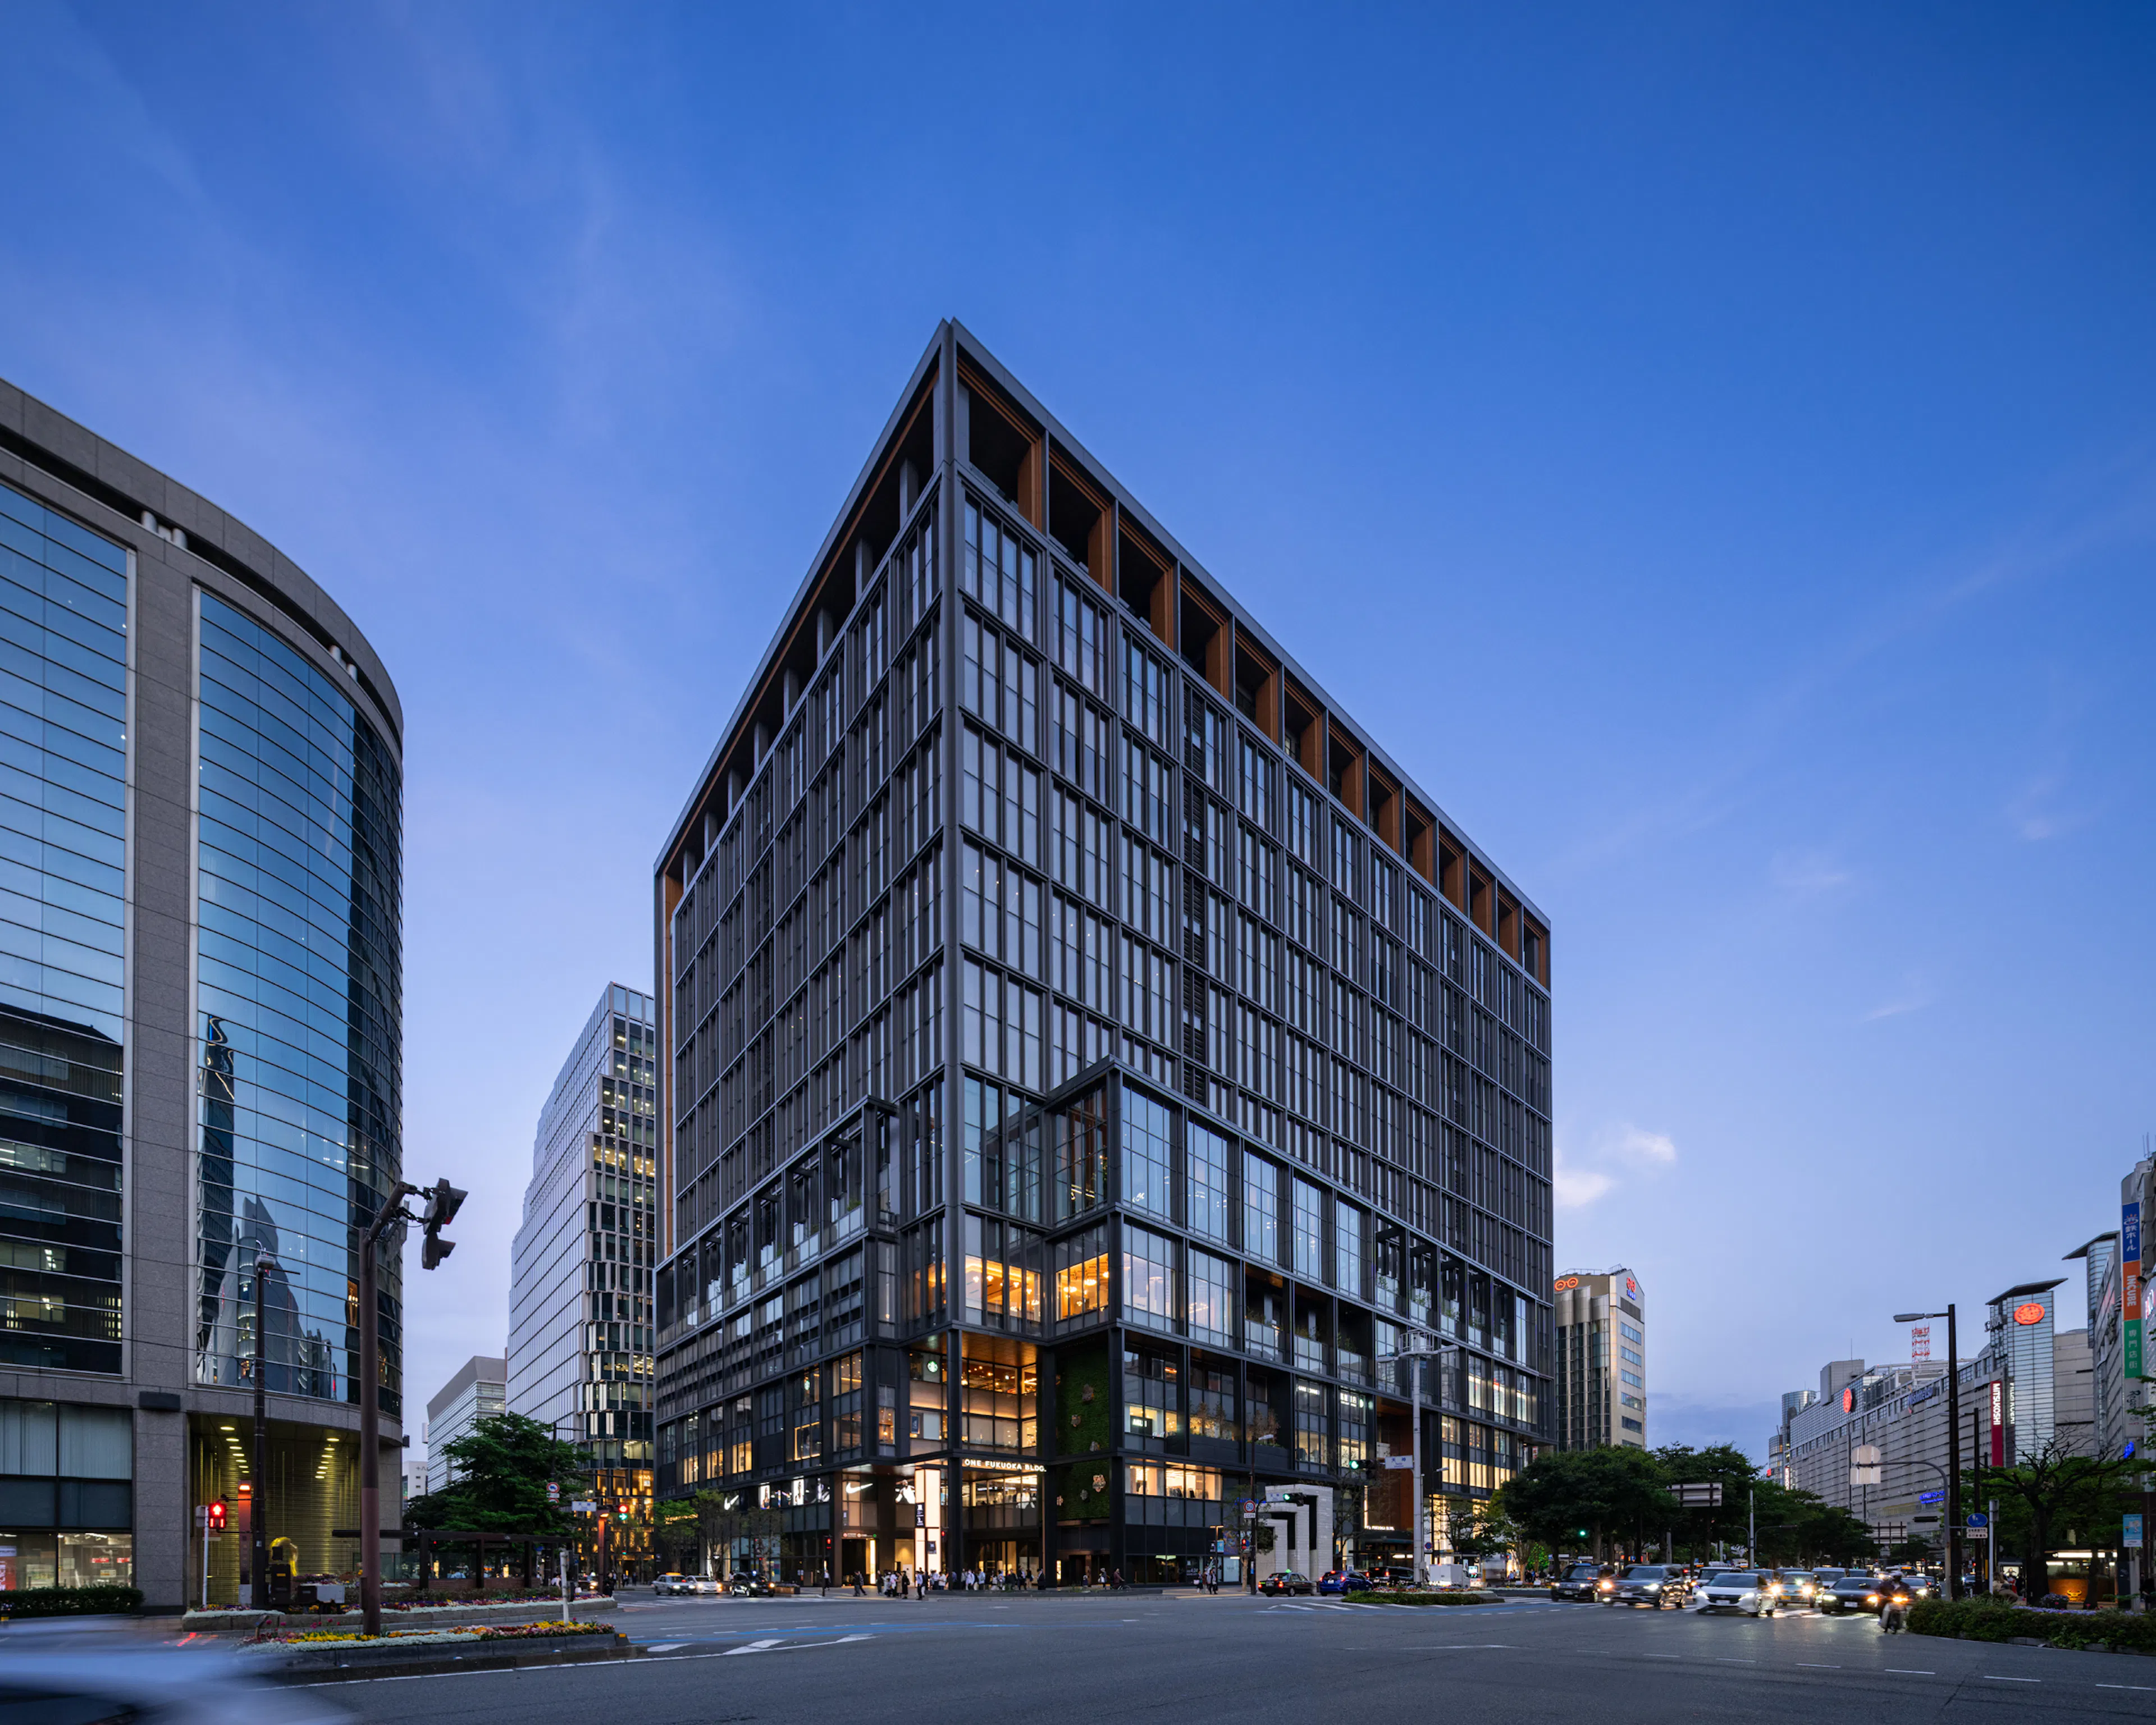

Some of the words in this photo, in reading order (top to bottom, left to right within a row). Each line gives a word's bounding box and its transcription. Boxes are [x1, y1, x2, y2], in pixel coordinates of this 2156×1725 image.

[2127, 1275, 2136, 1307] INCUBE
[1993, 1383, 2001, 1425] MITSUKOSHI
[985, 1461, 1022, 1470] FUKUOKA
[1025, 1464, 1047, 1472] BLDG.
